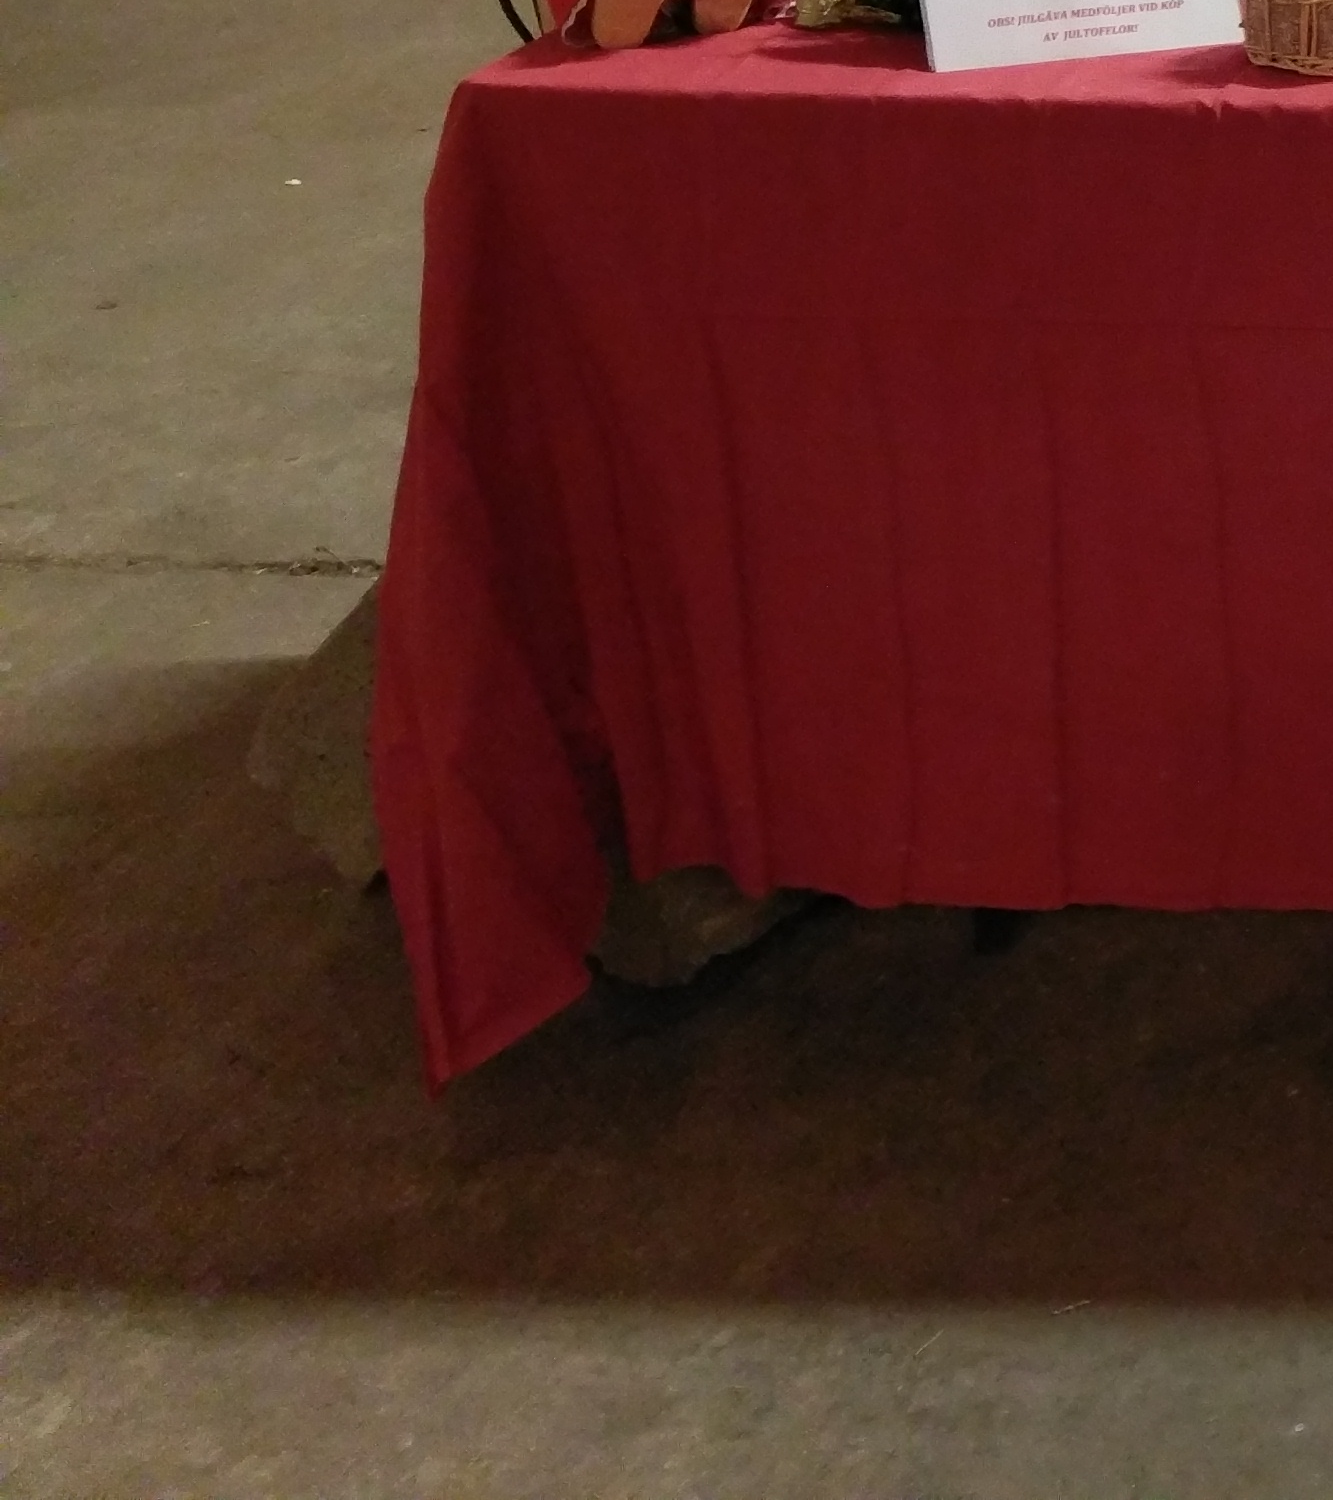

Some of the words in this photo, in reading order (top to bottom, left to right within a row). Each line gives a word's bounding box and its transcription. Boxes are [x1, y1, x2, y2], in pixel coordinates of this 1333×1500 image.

[1069, 3, 1137, 19] MEDFÖLJER
[1137, 1, 1159, 13] VID
[1042, 31, 1060, 43] AV
